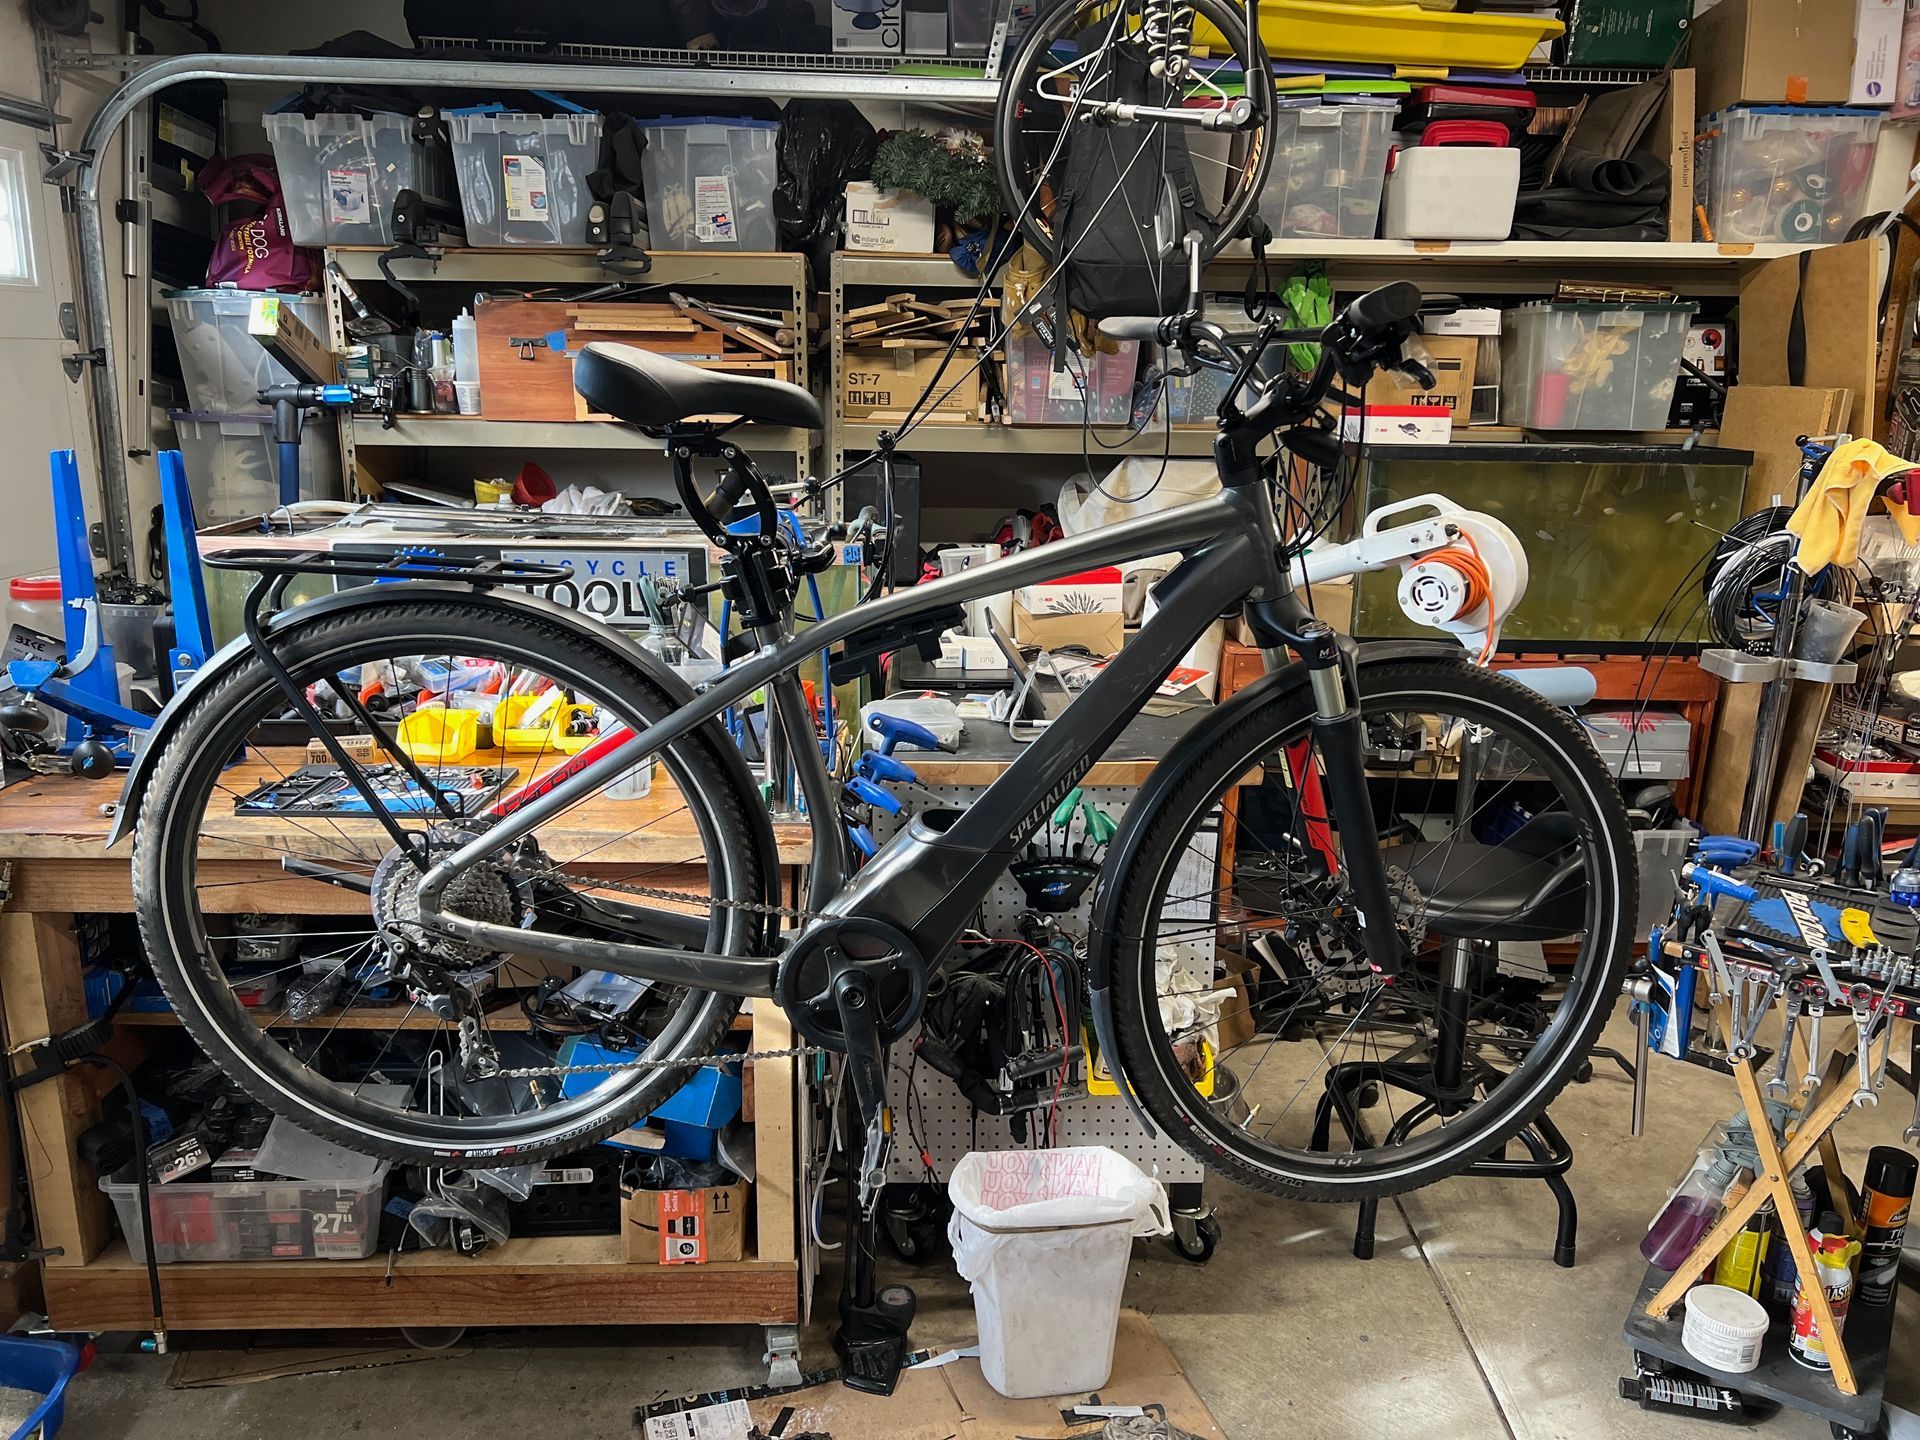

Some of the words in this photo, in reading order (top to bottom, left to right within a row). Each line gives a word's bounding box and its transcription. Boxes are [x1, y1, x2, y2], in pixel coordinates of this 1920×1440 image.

[275, 207, 286, 237] KIRKLAND
[250, 229, 269, 259] DOG
[848, 372, 881, 386] ST-7
[512, 559, 677, 577] YCLE
[979, 656, 995, 665] ring
[1832, 703, 1901, 729] BATRY
[1009, 753, 1091, 848] SPECIALIZED
[174, 1148, 202, 1172] 26"
[471, 1150, 494, 1158] SPORT
[312, 1212, 352, 1234] 27"
[1825, 1281, 1852, 1302] LAST
